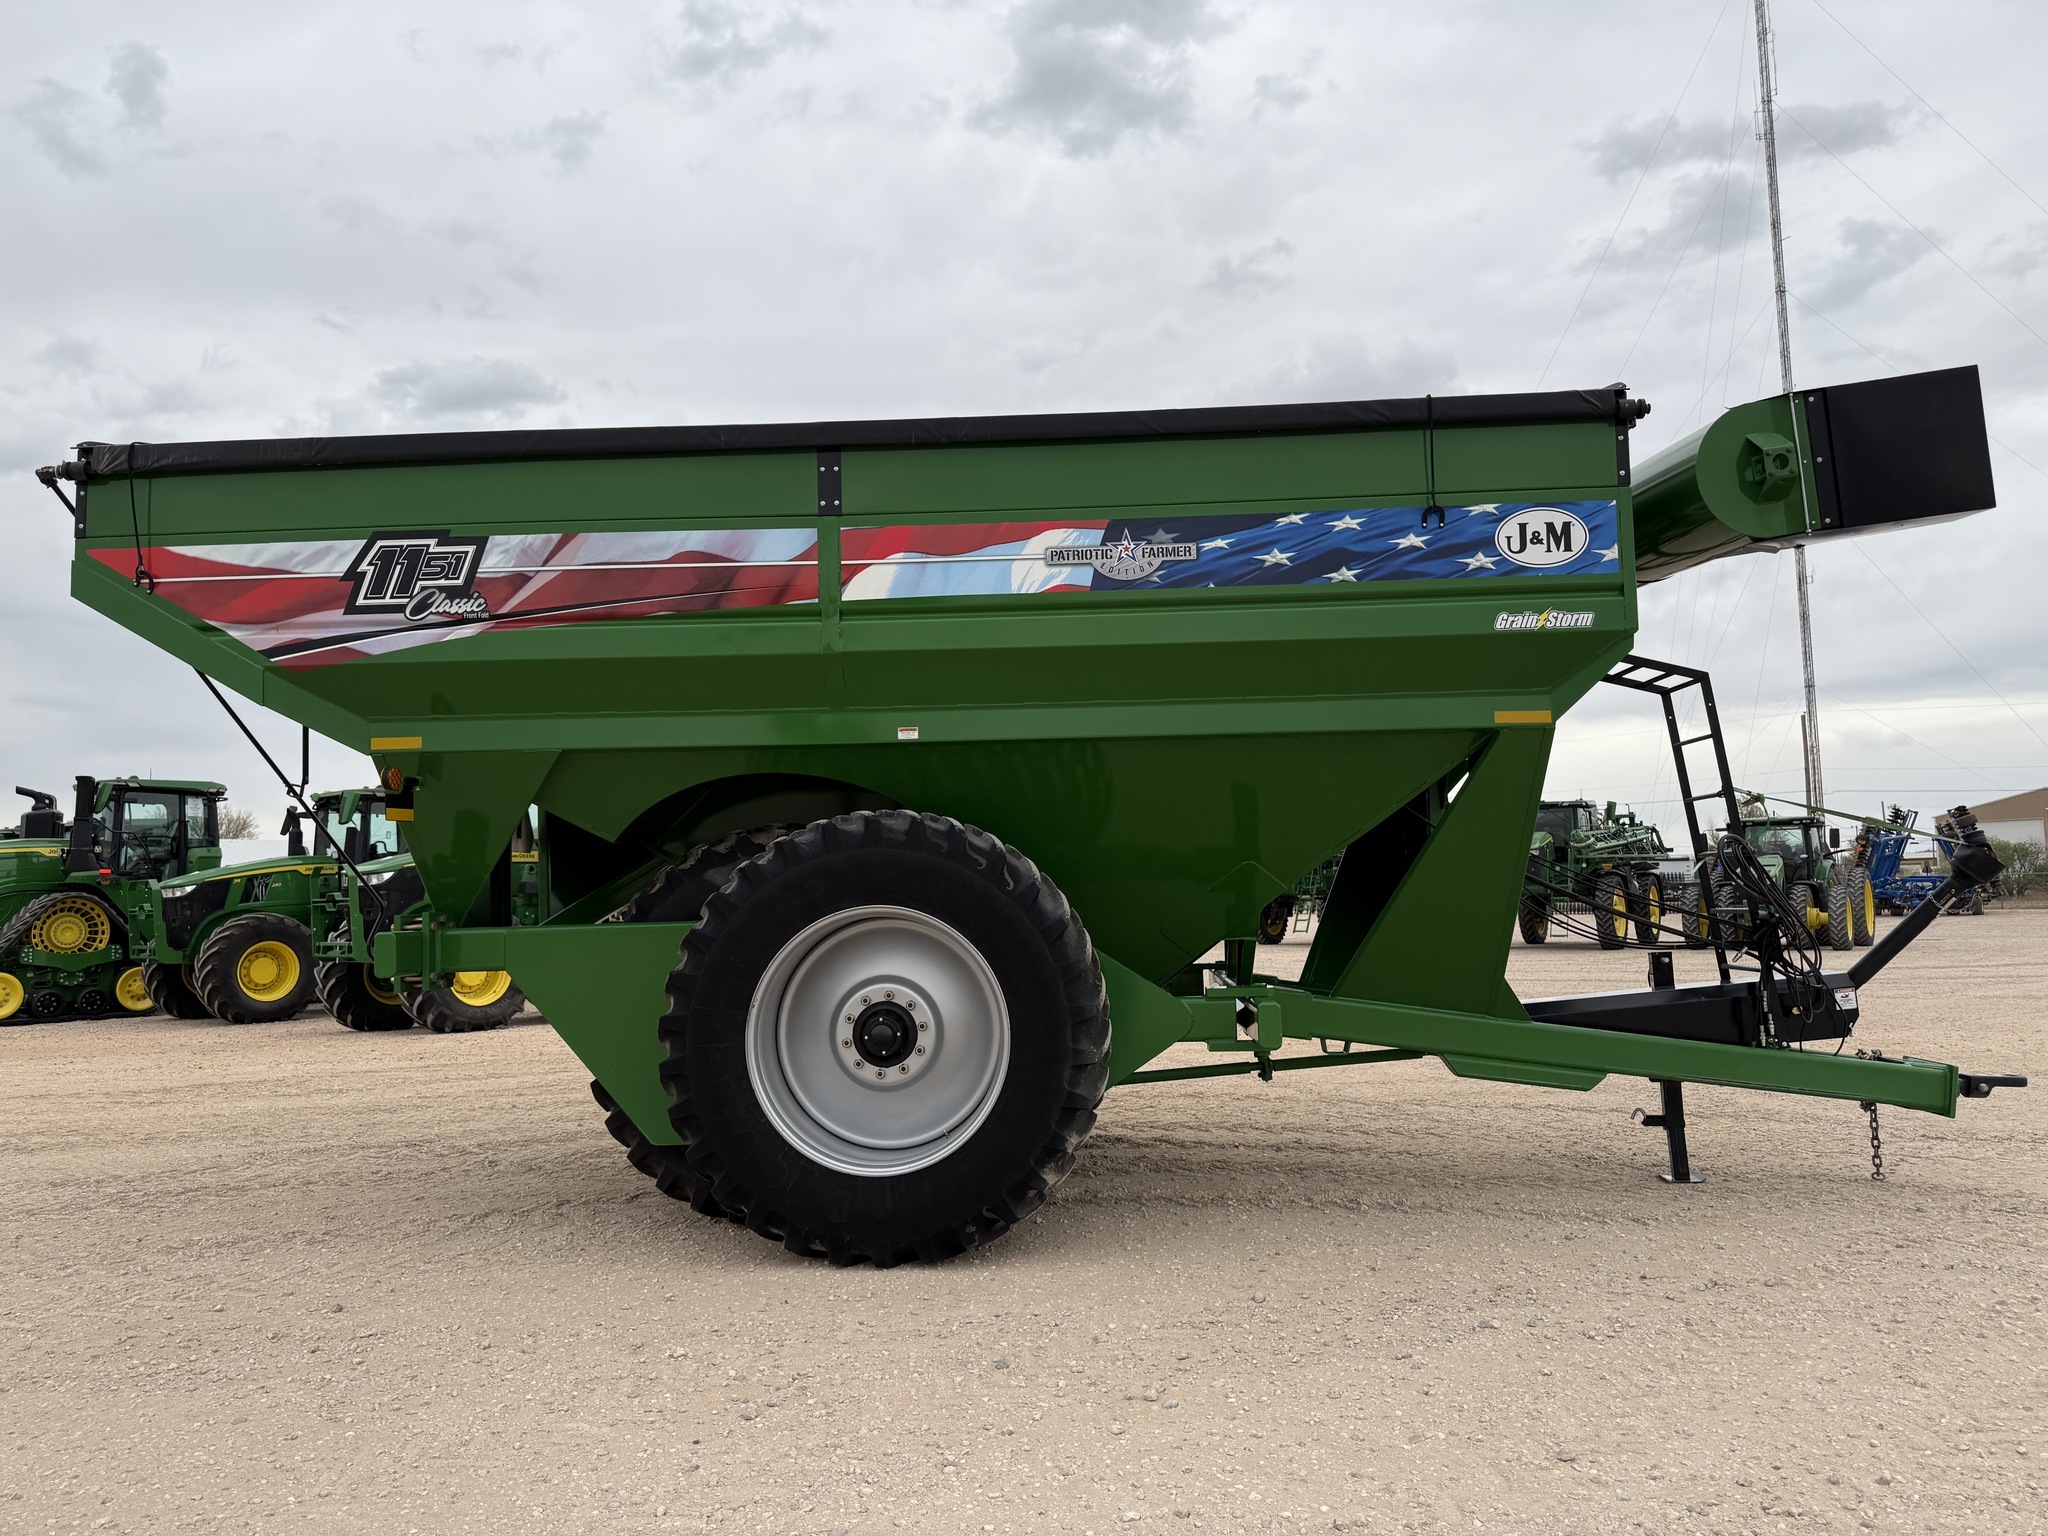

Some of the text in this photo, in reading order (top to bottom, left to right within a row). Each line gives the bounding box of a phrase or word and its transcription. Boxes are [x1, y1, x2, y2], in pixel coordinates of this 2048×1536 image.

[1504, 520, 1574, 555] J&M
[1050, 545, 1192, 562] PATRIOTIC FARMER
[1100, 562, 1154, 576] EDITION
[405, 588, 487, 620] Classic
[478, 611, 490, 619] Fold
[1495, 611, 1594, 630] Grain Storm
